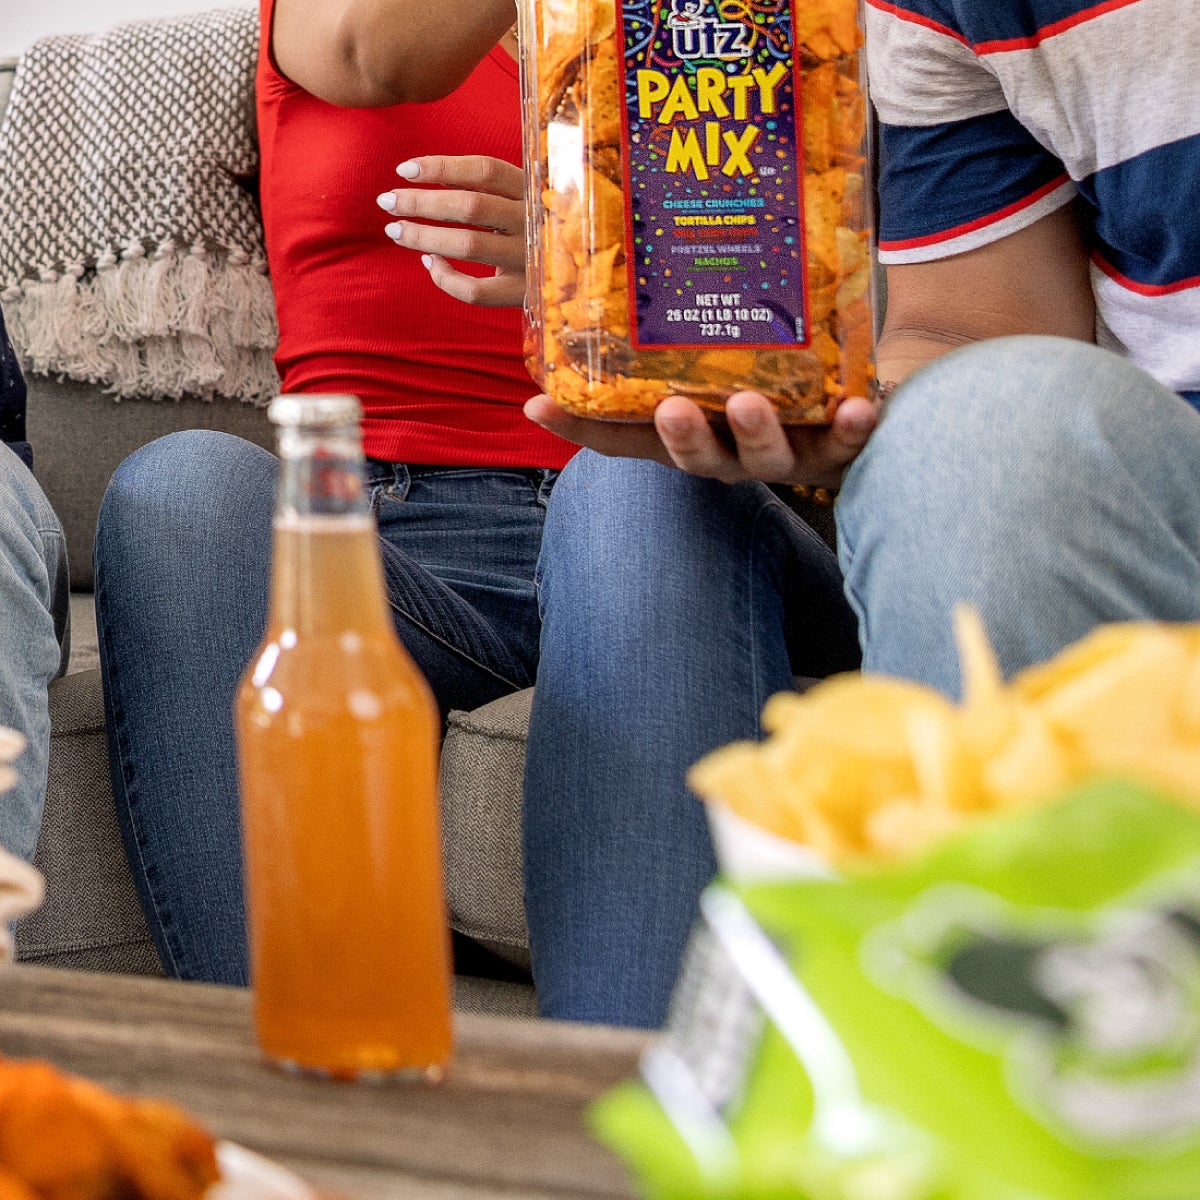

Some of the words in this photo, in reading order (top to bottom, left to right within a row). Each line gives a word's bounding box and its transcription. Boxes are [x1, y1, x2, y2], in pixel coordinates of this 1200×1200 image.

[637, 62, 788, 124] PARTY
[665, 121, 760, 181] MIX
[662, 199, 703, 209] CHEESE
[705, 198, 765, 209] CRUNCHIES
[673, 215, 723, 226] TORTILLA
[723, 214, 757, 225] CHIPS
[696, 294, 719, 307] NET
[720, 293, 741, 306] WT
[666, 309, 683, 322] 26
[683, 309, 700, 322] OZ
[702, 309, 714, 323] (1
[716, 309, 732, 322] LB
[734, 308, 750, 321] 10
[751, 307, 773, 323] OZ)
[699, 323, 741, 338] 737.1g
